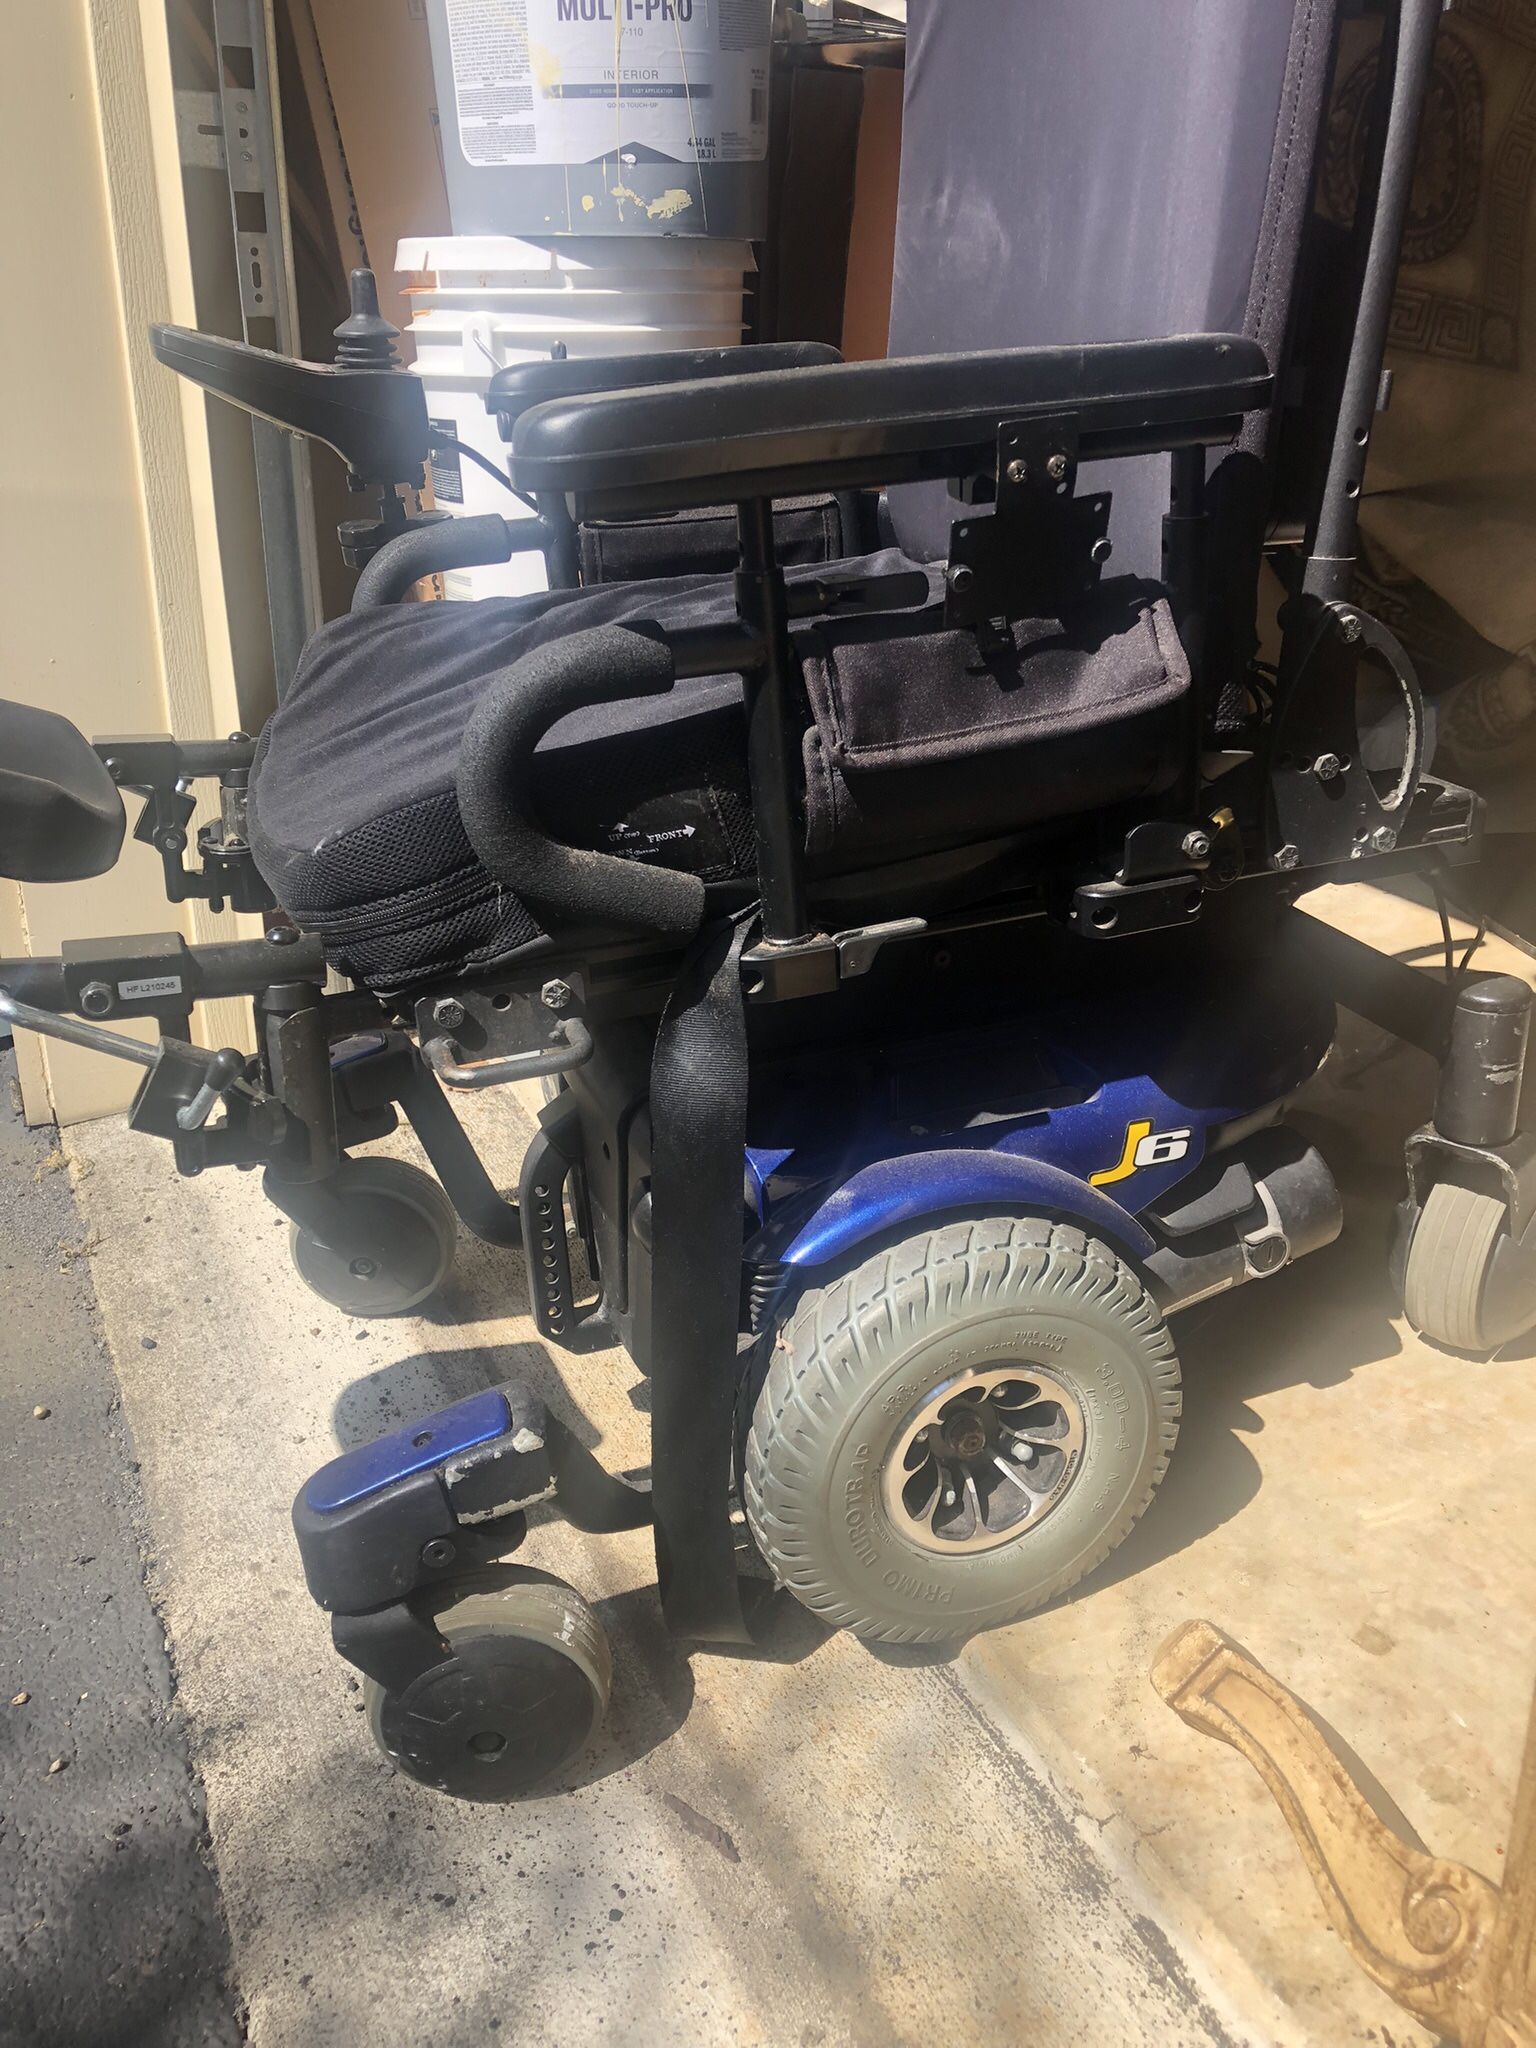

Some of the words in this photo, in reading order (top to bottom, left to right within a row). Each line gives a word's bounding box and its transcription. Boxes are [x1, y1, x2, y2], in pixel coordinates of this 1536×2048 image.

[557, 0, 693, 21] MULI-PRO
[603, 70, 659, 80] INTERIOR
[704, 138, 716, 147] GAL
[608, 833, 622, 841] UP
[646, 829, 682, 843] FRONT
[126, 985, 139, 993] HF
[1090, 1121, 1190, 1186] J6
[882, 1568, 957, 1602] PRIMO
